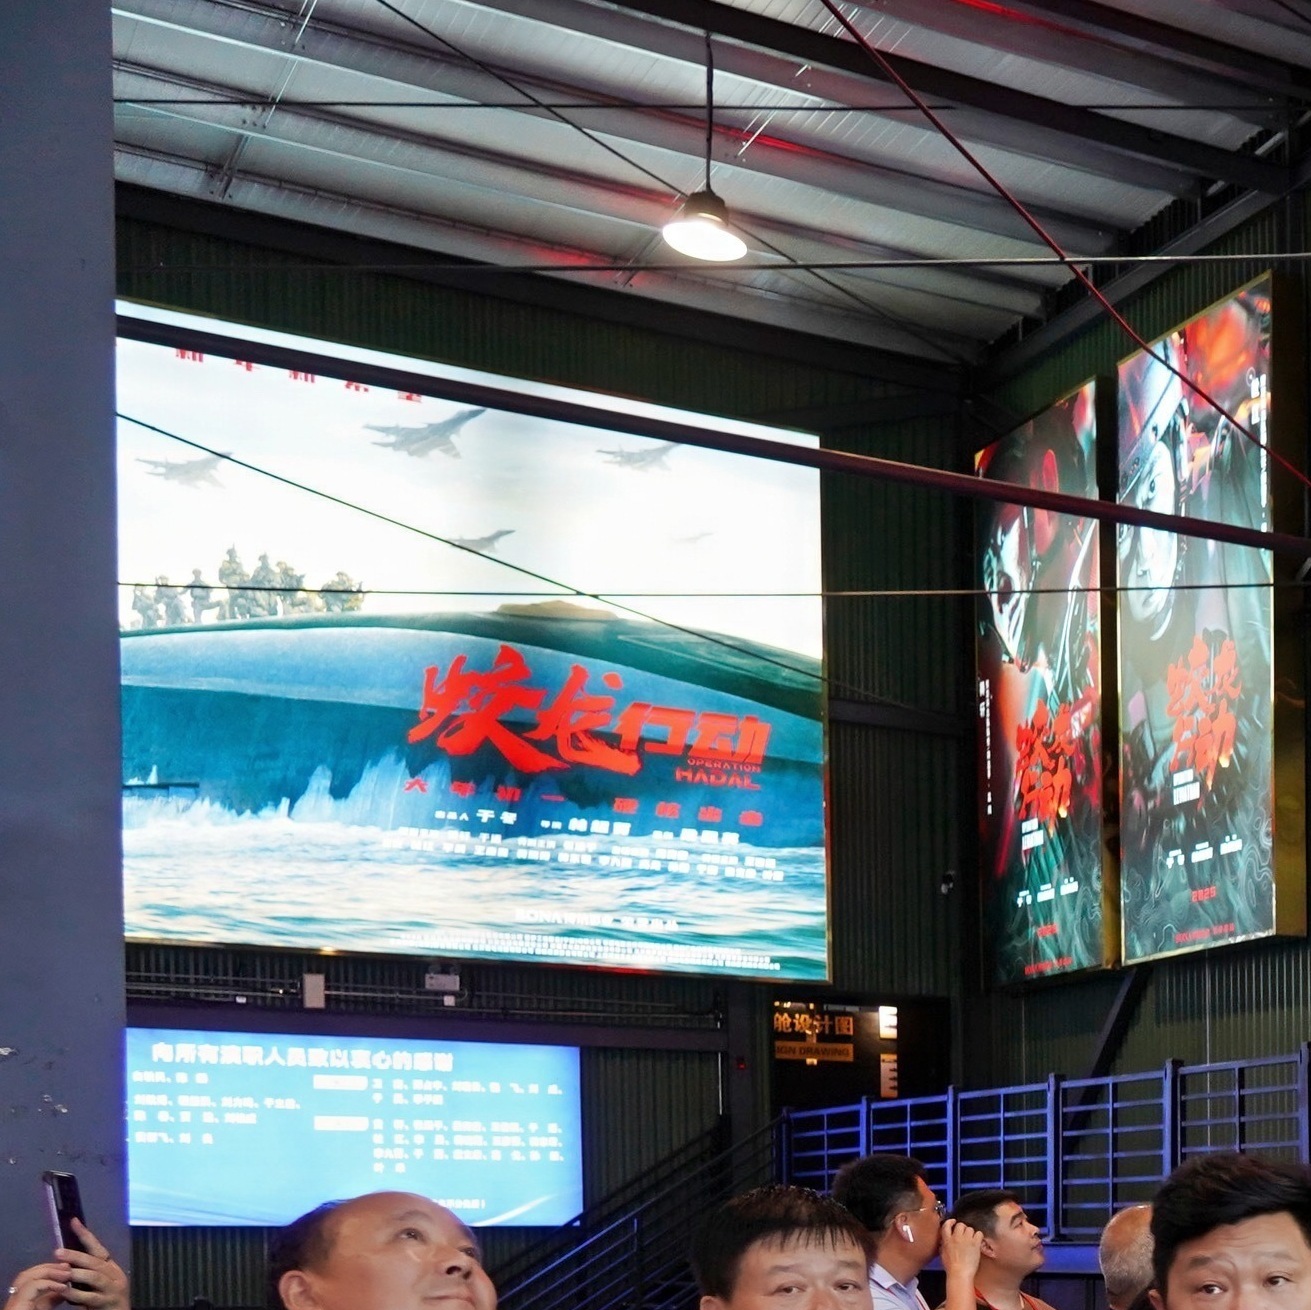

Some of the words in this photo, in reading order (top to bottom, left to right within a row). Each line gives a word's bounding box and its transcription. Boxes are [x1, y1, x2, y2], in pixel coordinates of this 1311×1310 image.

[407, 644, 772, 776] 蛟龙行动
[687, 758, 762, 773] OPERATION
[675, 767, 762, 790] HADAL
